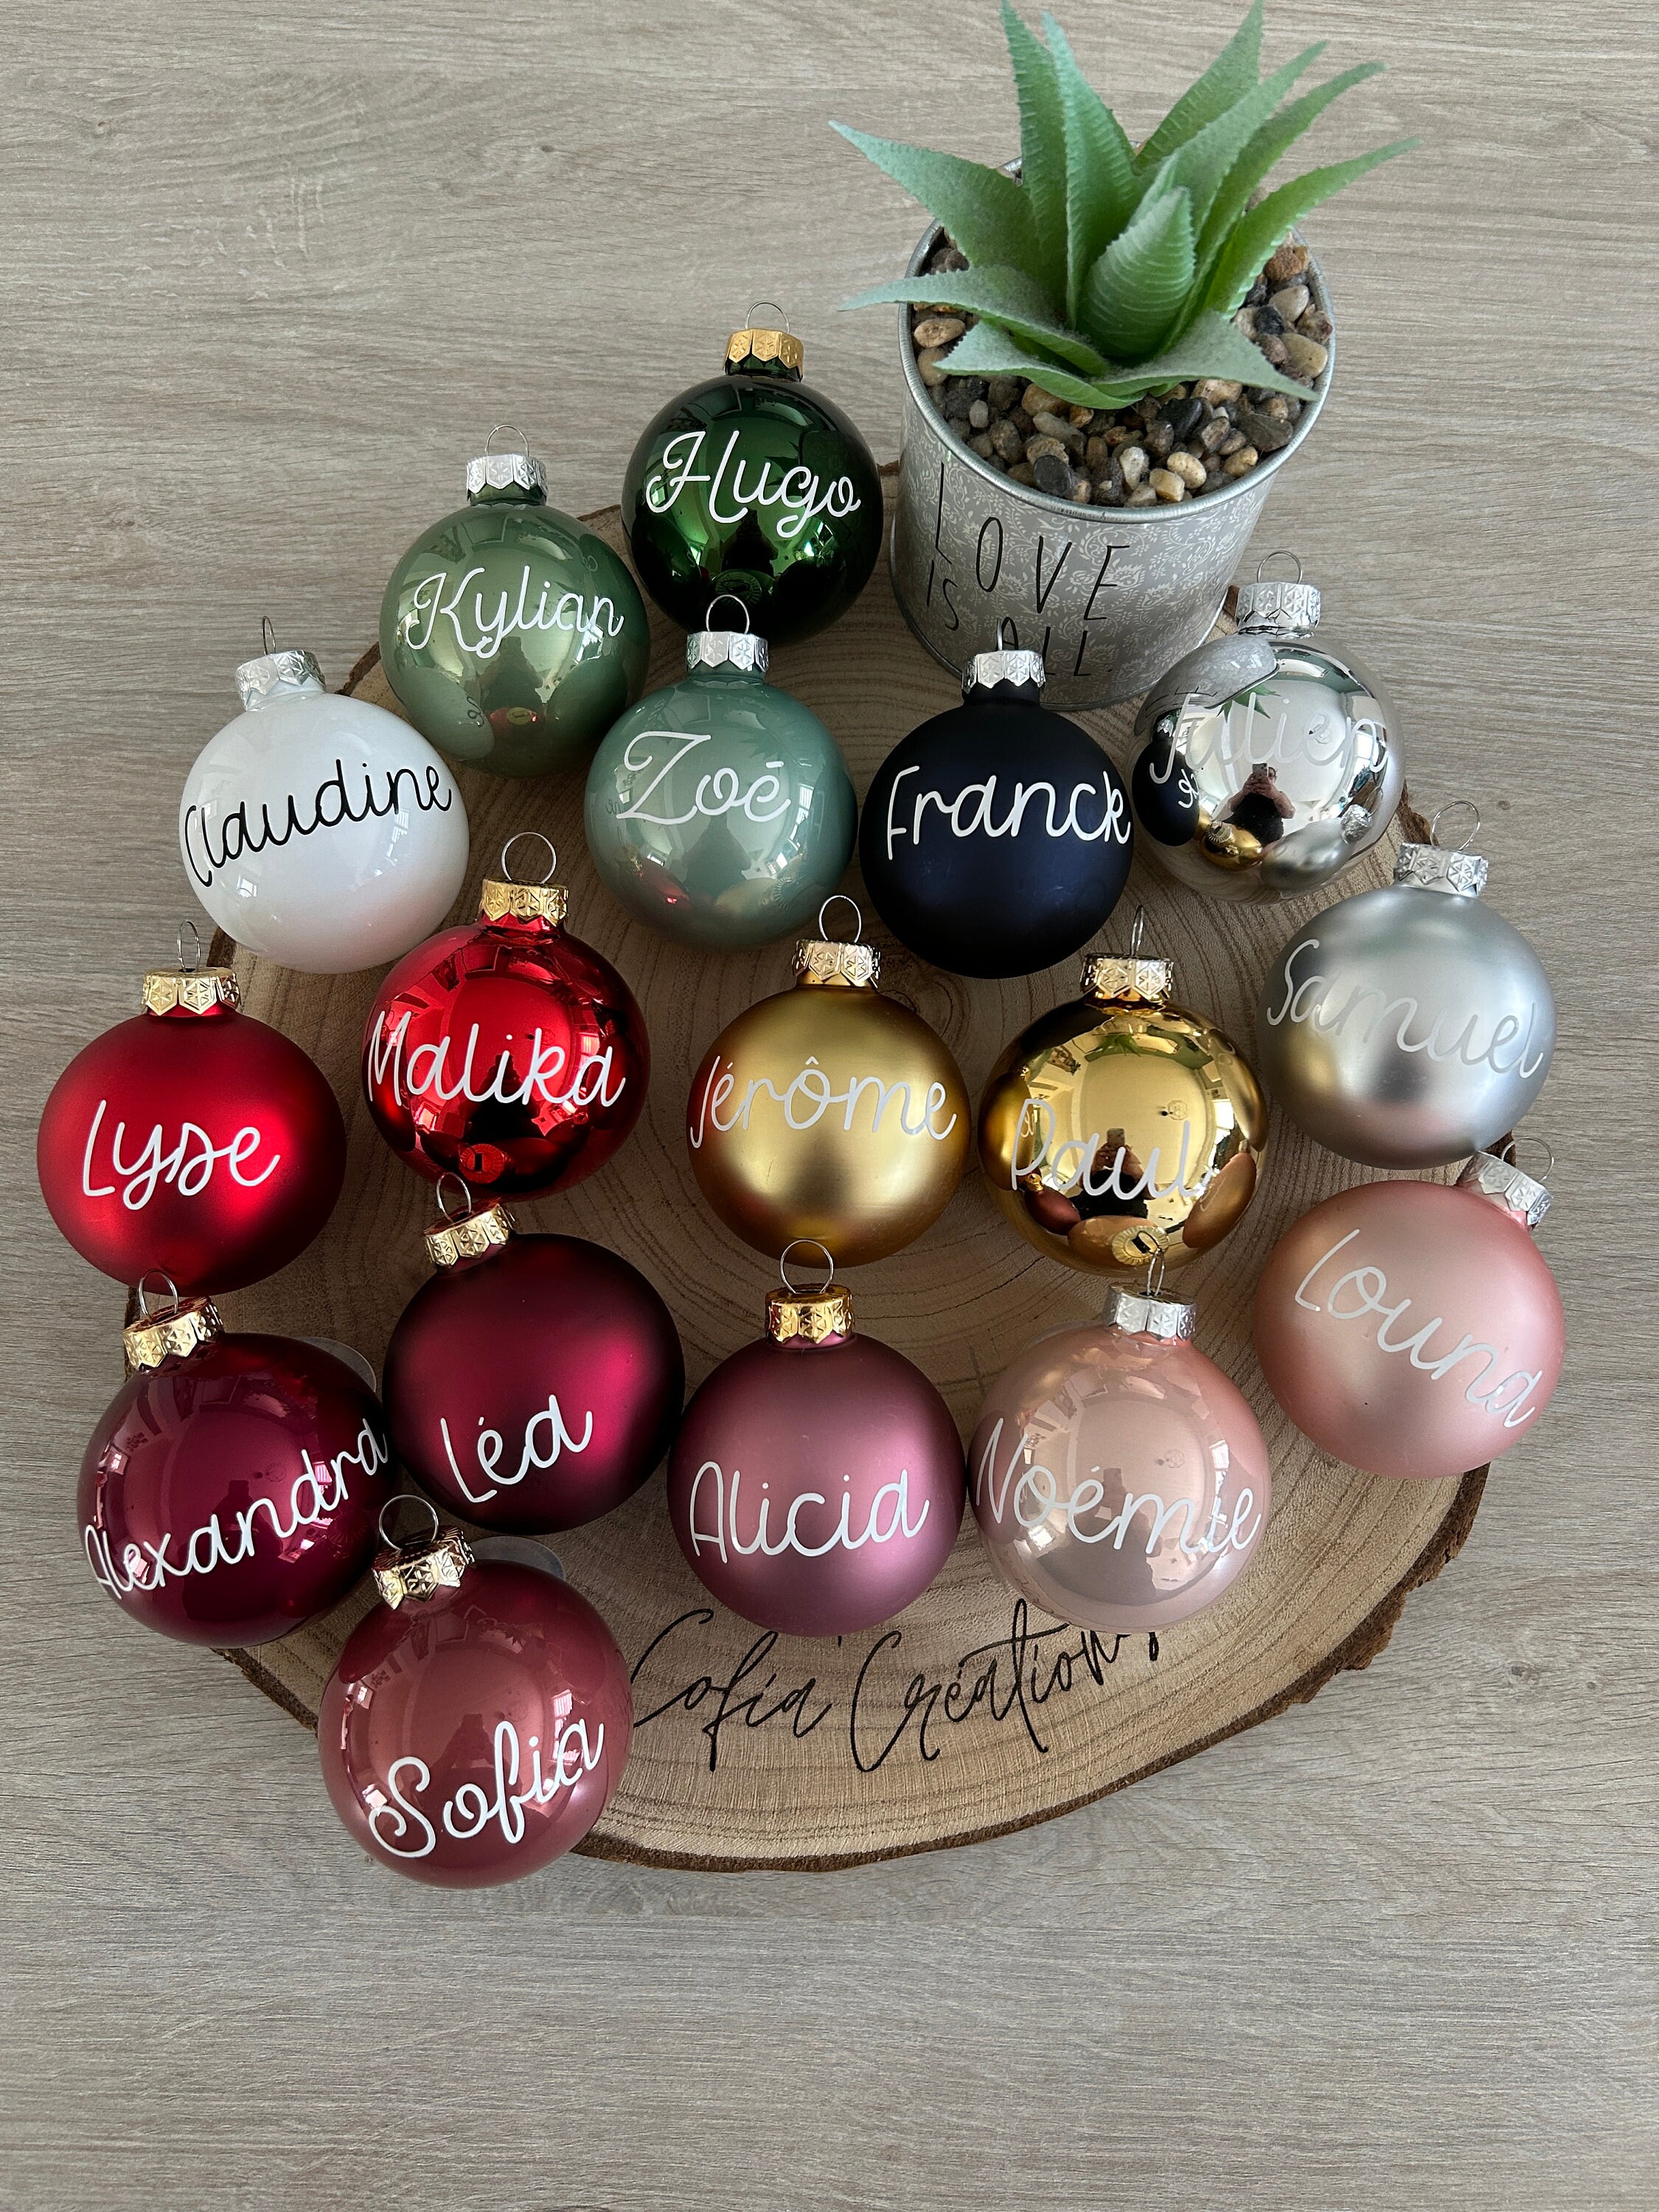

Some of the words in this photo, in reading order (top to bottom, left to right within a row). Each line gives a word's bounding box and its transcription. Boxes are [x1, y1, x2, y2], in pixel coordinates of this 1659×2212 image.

[647, 430, 861, 538] Hugo
[926, 559, 959, 631] IS
[934, 462, 1130, 621] LOVE
[407, 566, 625, 658] Kylian
[616, 730, 791, 825] Zoé
[1149, 692, 1390, 785] Julien
[184, 758, 453, 888] Claudine
[886, 765, 1131, 861] Franck
[366, 1009, 627, 1107] Malika
[1266, 938, 1544, 1079] Samuel
[82, 1099, 281, 1211] Lyse
[689, 1054, 958, 1150] Jérôme
[1011, 1097, 1214, 1201] Paul
[1294, 1228, 1543, 1428] Louna
[440, 1394, 594, 1503] Léa
[975, 1416, 1262, 1554] Noémie
[84, 1418, 389, 1600] Alexandra
[689, 1461, 931, 1565] Alicia
[368, 1717, 605, 1858] Sofia
